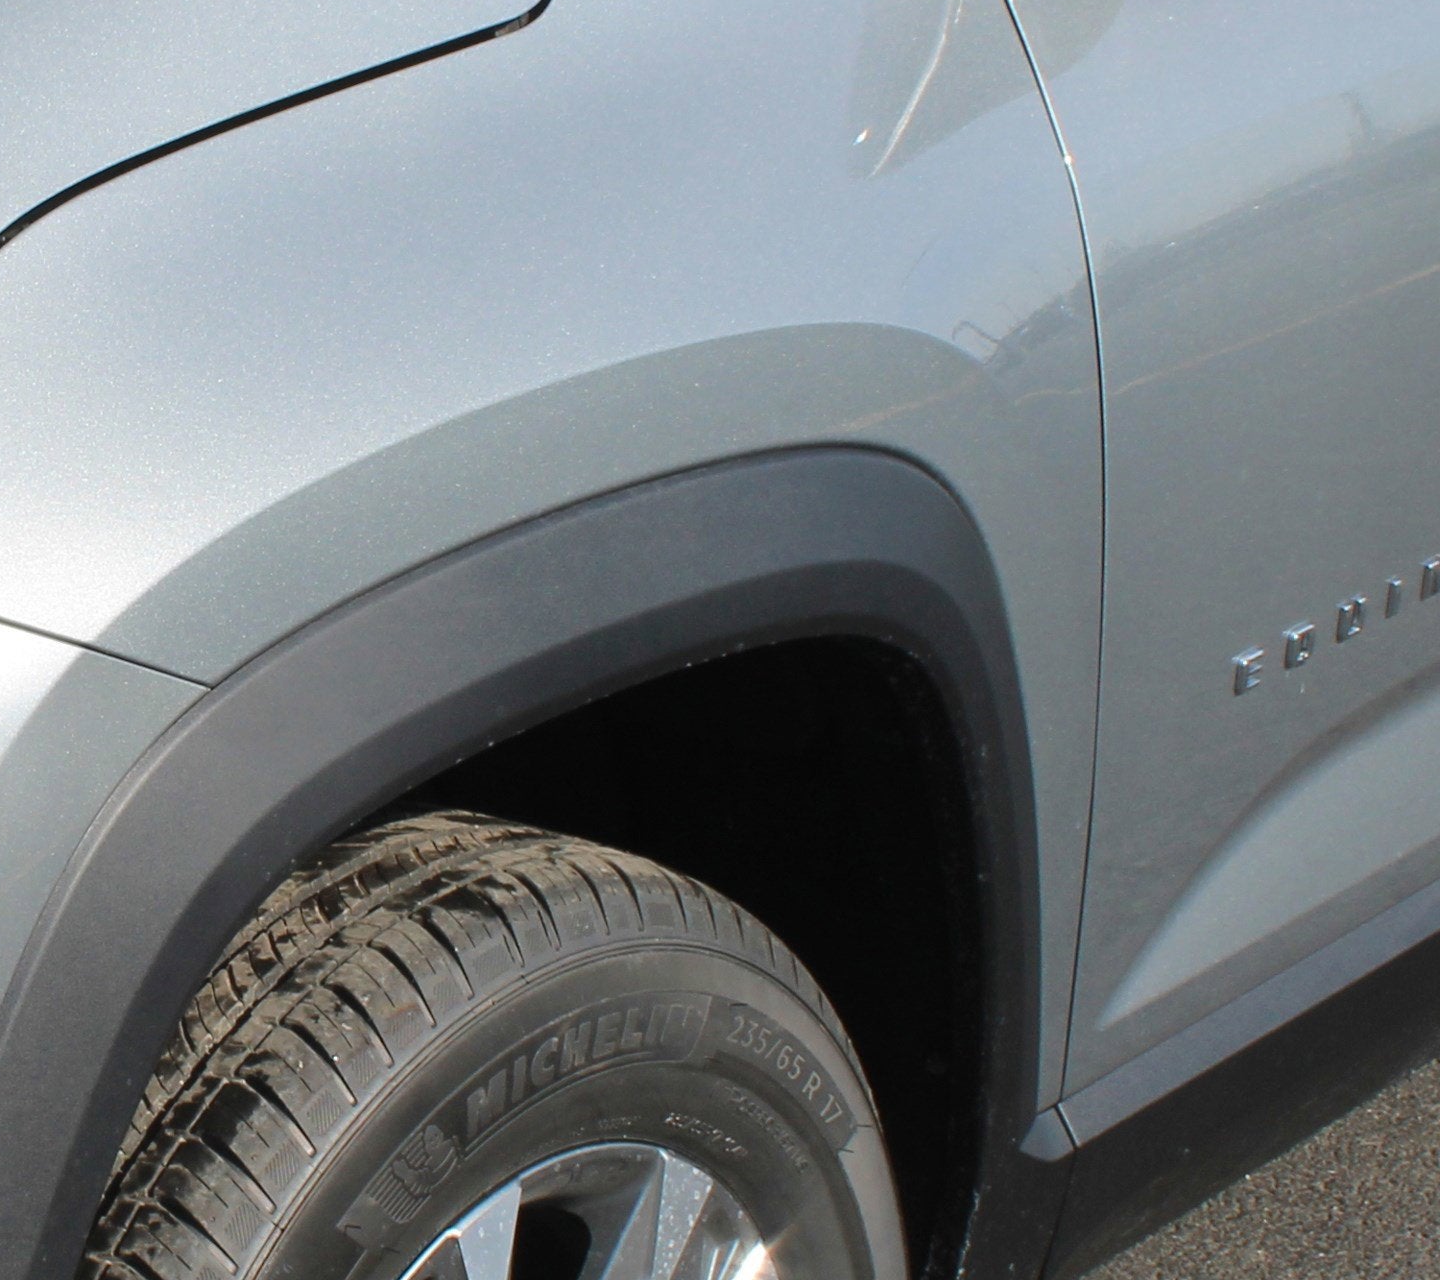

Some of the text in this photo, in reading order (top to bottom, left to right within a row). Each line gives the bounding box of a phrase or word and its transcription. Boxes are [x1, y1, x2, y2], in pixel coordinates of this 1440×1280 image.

[466, 1003, 705, 1139] MICHELIN
[725, 1015, 844, 1125] 235/65 R 17
